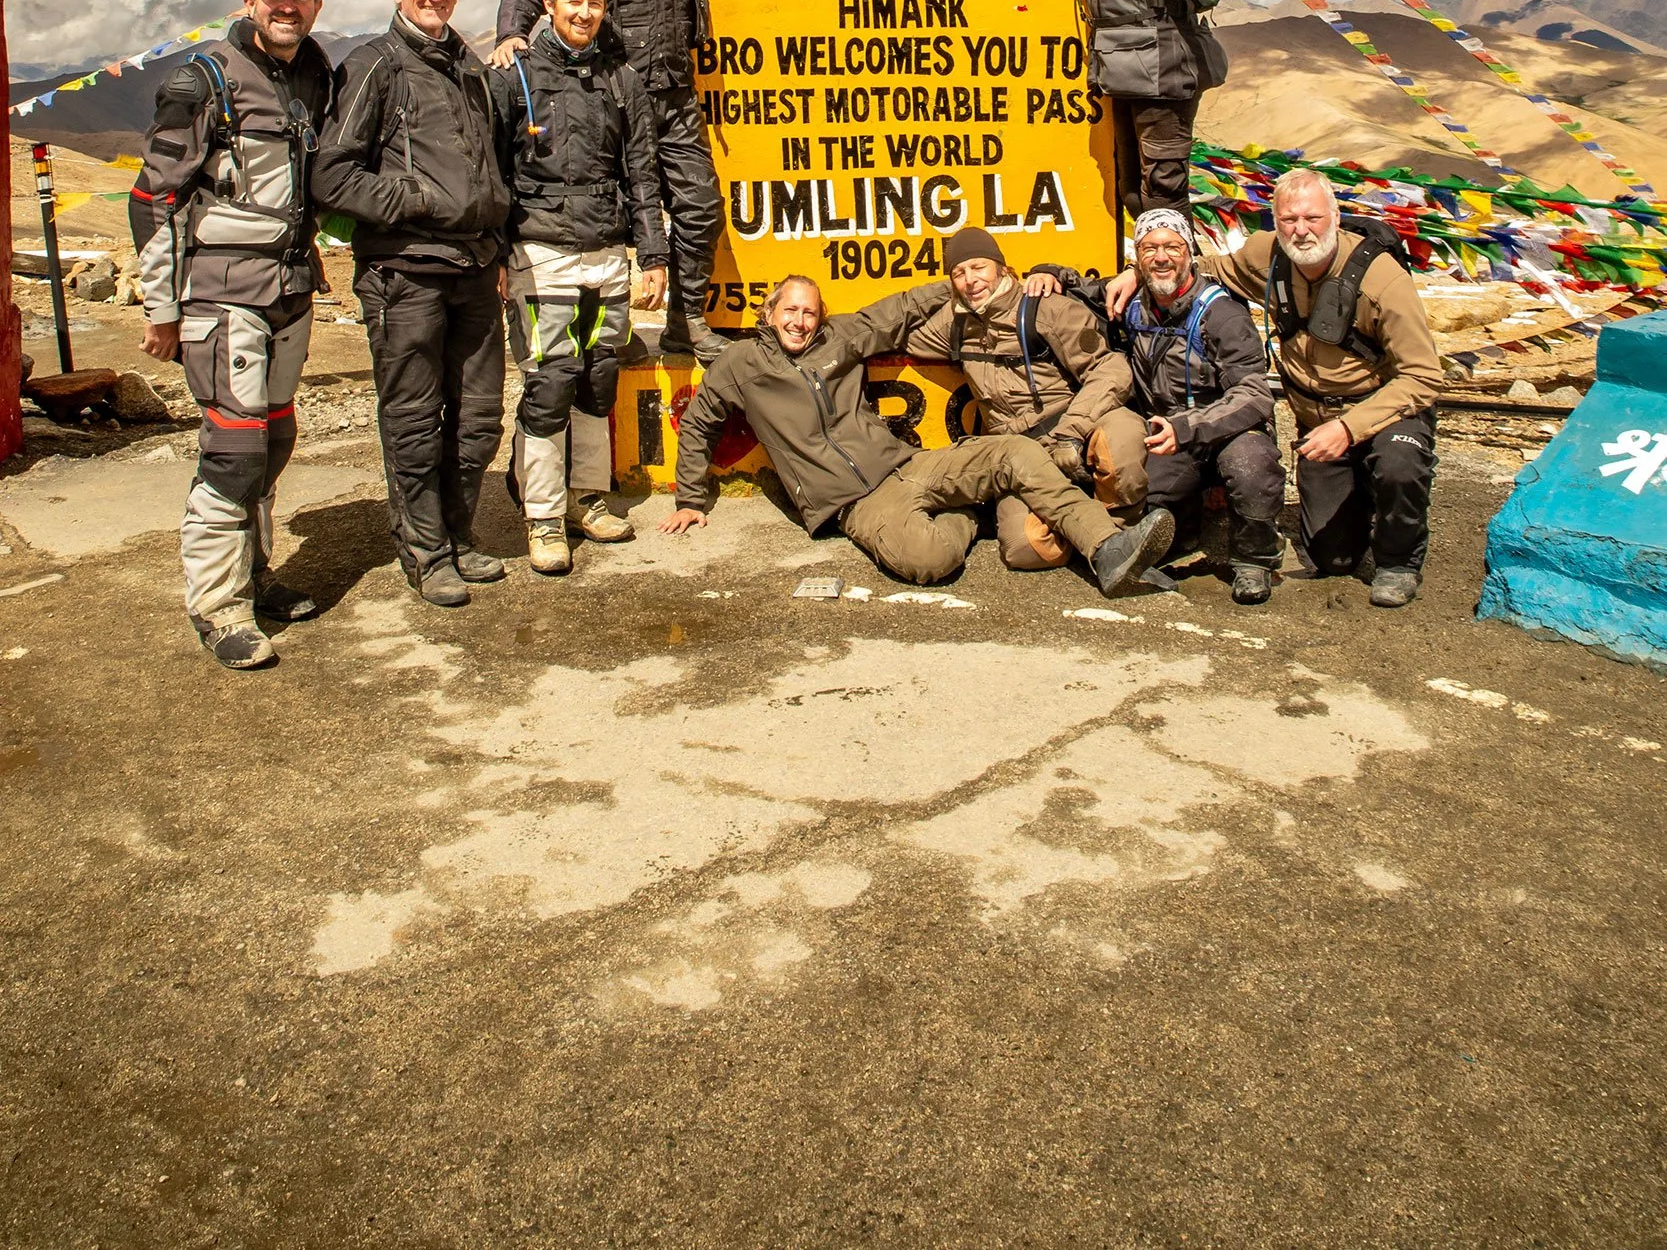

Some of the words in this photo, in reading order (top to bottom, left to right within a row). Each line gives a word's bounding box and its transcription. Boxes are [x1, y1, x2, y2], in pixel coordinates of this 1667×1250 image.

[698, 36, 764, 75] BRO
[775, 35, 955, 76] WELCOMES
[961, 35, 1028, 77] YOU
[1040, 36, 1083, 80] TO
[825, 86, 1008, 123] MOTORABLE
[1027, 88, 1104, 125] PASS
[782, 137, 811, 171] IN
[819, 135, 875, 170] THE
[886, 133, 1004, 168] WORLD
[730, 175, 968, 241] UMLING
[983, 170, 1075, 234] LA
[823, 238, 951, 280] 19024
